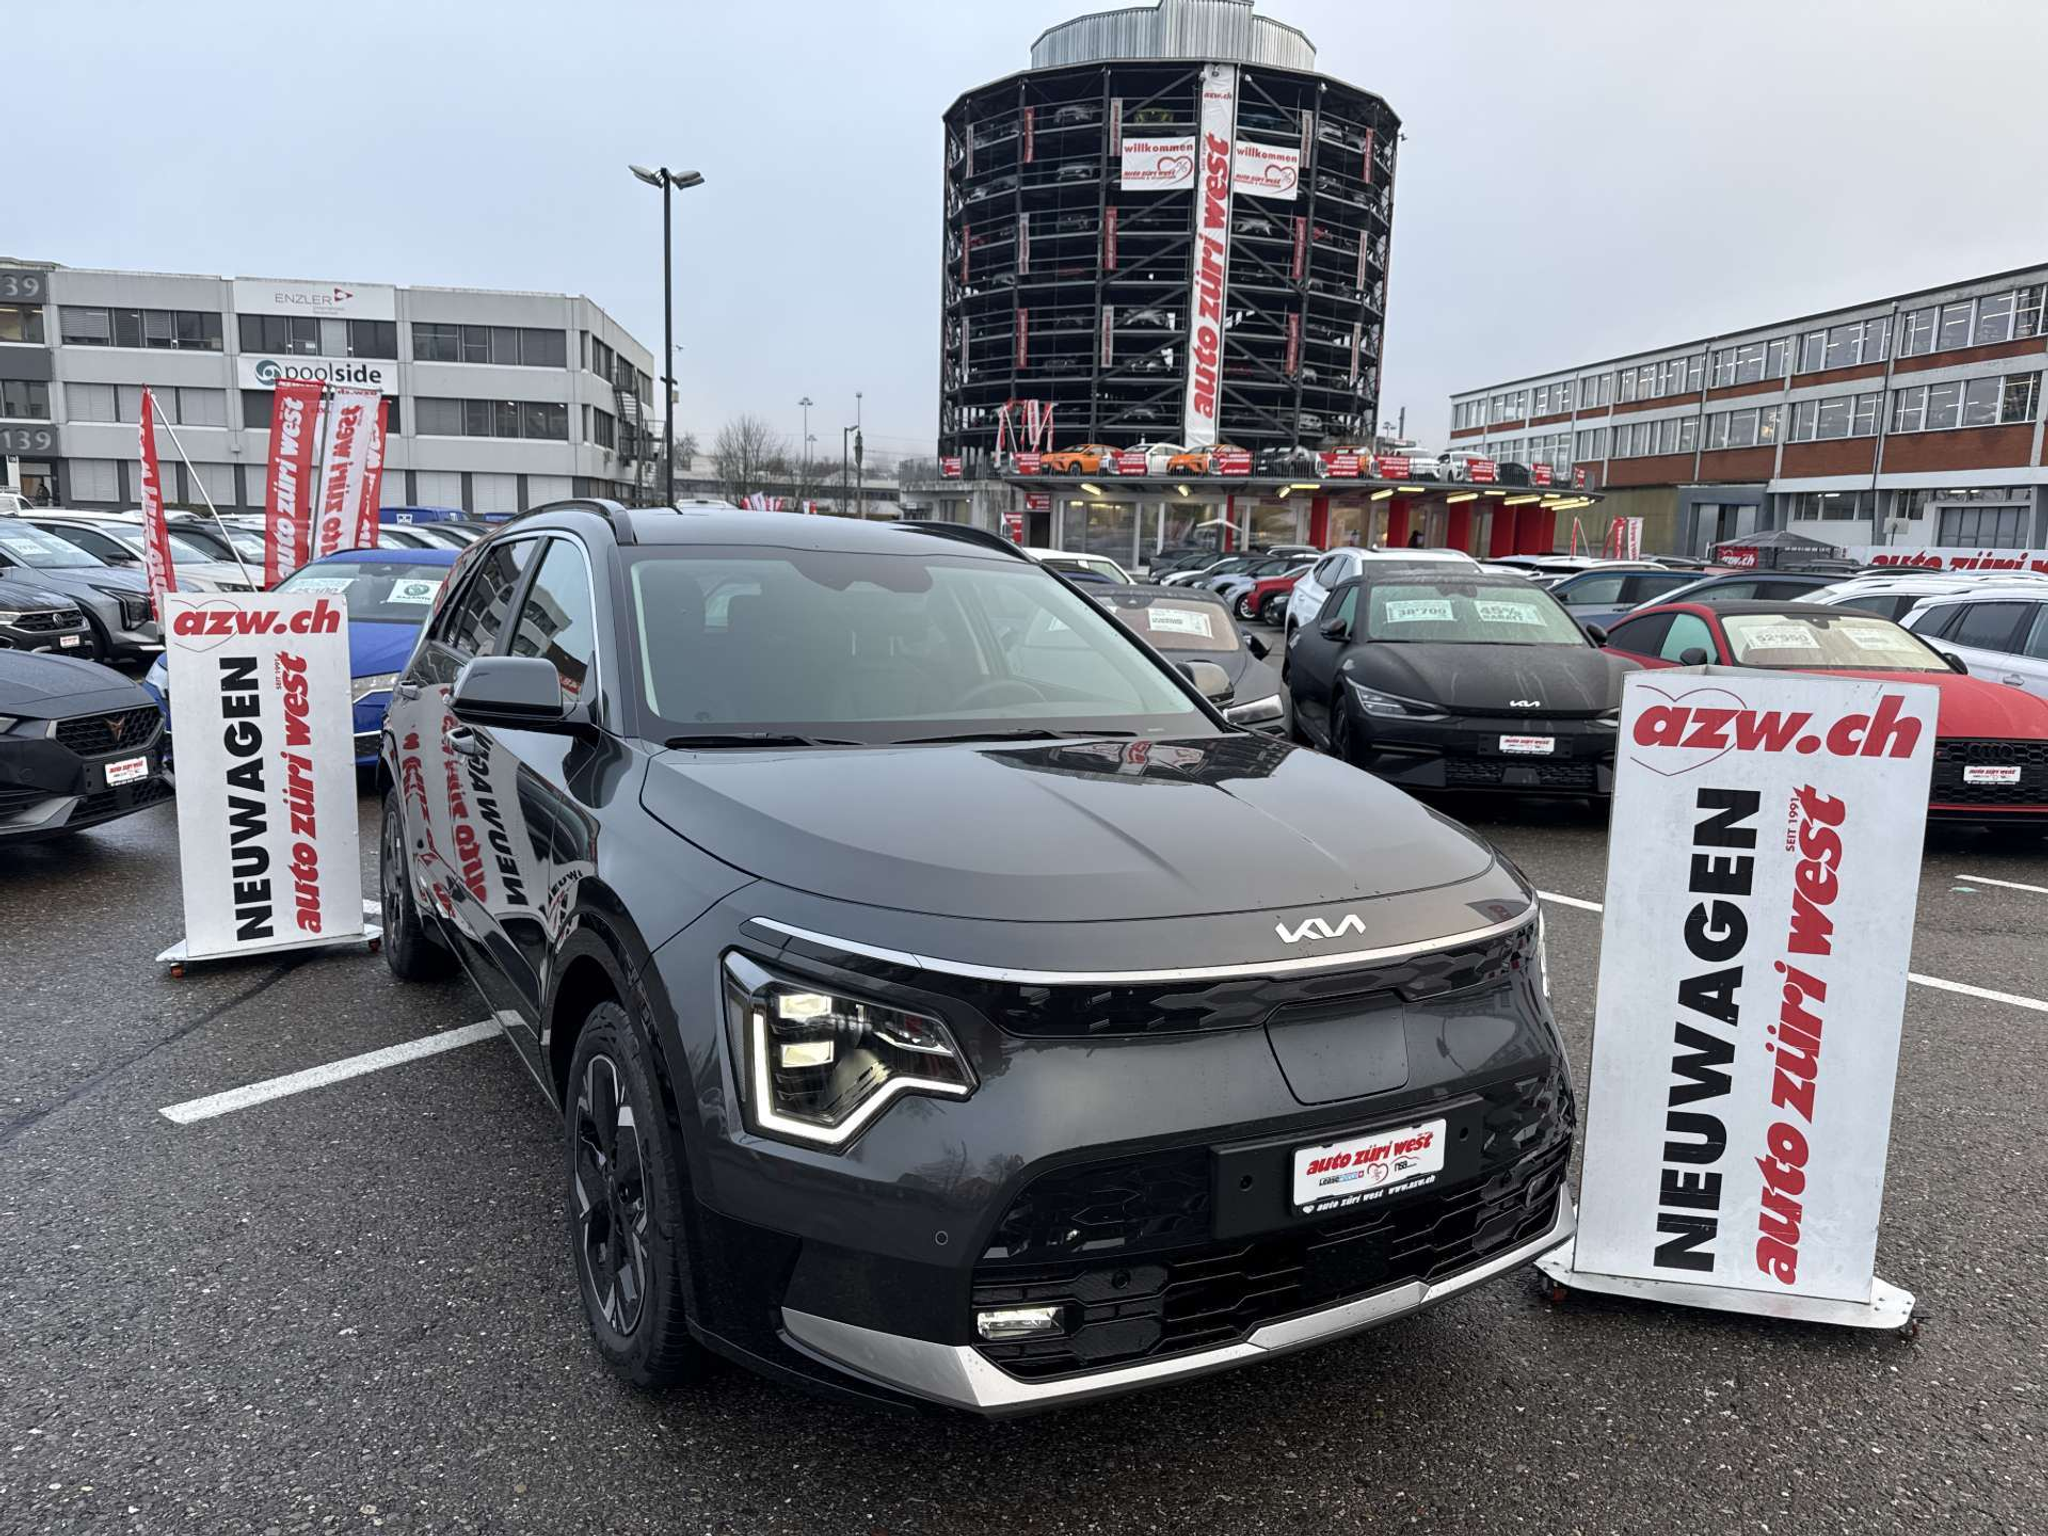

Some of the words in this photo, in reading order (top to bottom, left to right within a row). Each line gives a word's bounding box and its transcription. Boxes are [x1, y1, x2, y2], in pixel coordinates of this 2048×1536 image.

[1124, 143, 1193, 153] willkommen
[1203, 131, 1230, 229] west
[1236, 147, 1298, 162] willkommen
[275, 293, 333, 305] ENZLER
[1195, 233, 1225, 325] züri
[285, 363, 382, 384] poolside
[1187, 326, 1218, 419] auto
[2, 430, 52, 450] 139
[280, 396, 304, 457] west
[274, 457, 299, 517] züri
[173, 599, 341, 636] azw.ch
[275, 651, 311, 746] west
[1632, 695, 1923, 760] azw.ch
[219, 656, 274, 942] NEUWAGEN
[280, 751, 317, 840] züri
[1788, 797, 1800, 824] 1991
[1785, 828, 1797, 852] SEIT
[1788, 784, 1848, 956] west
[287, 842, 322, 934] auto
[1653, 787, 1762, 1273] NEUWAGEN
[1765, 960, 1828, 1126] züri
[1306, 1152, 1352, 1176] auto
[1352, 1140, 1393, 1166] züri
[1394, 1131, 1434, 1155] west
[1755, 1120, 1812, 1287] auto
